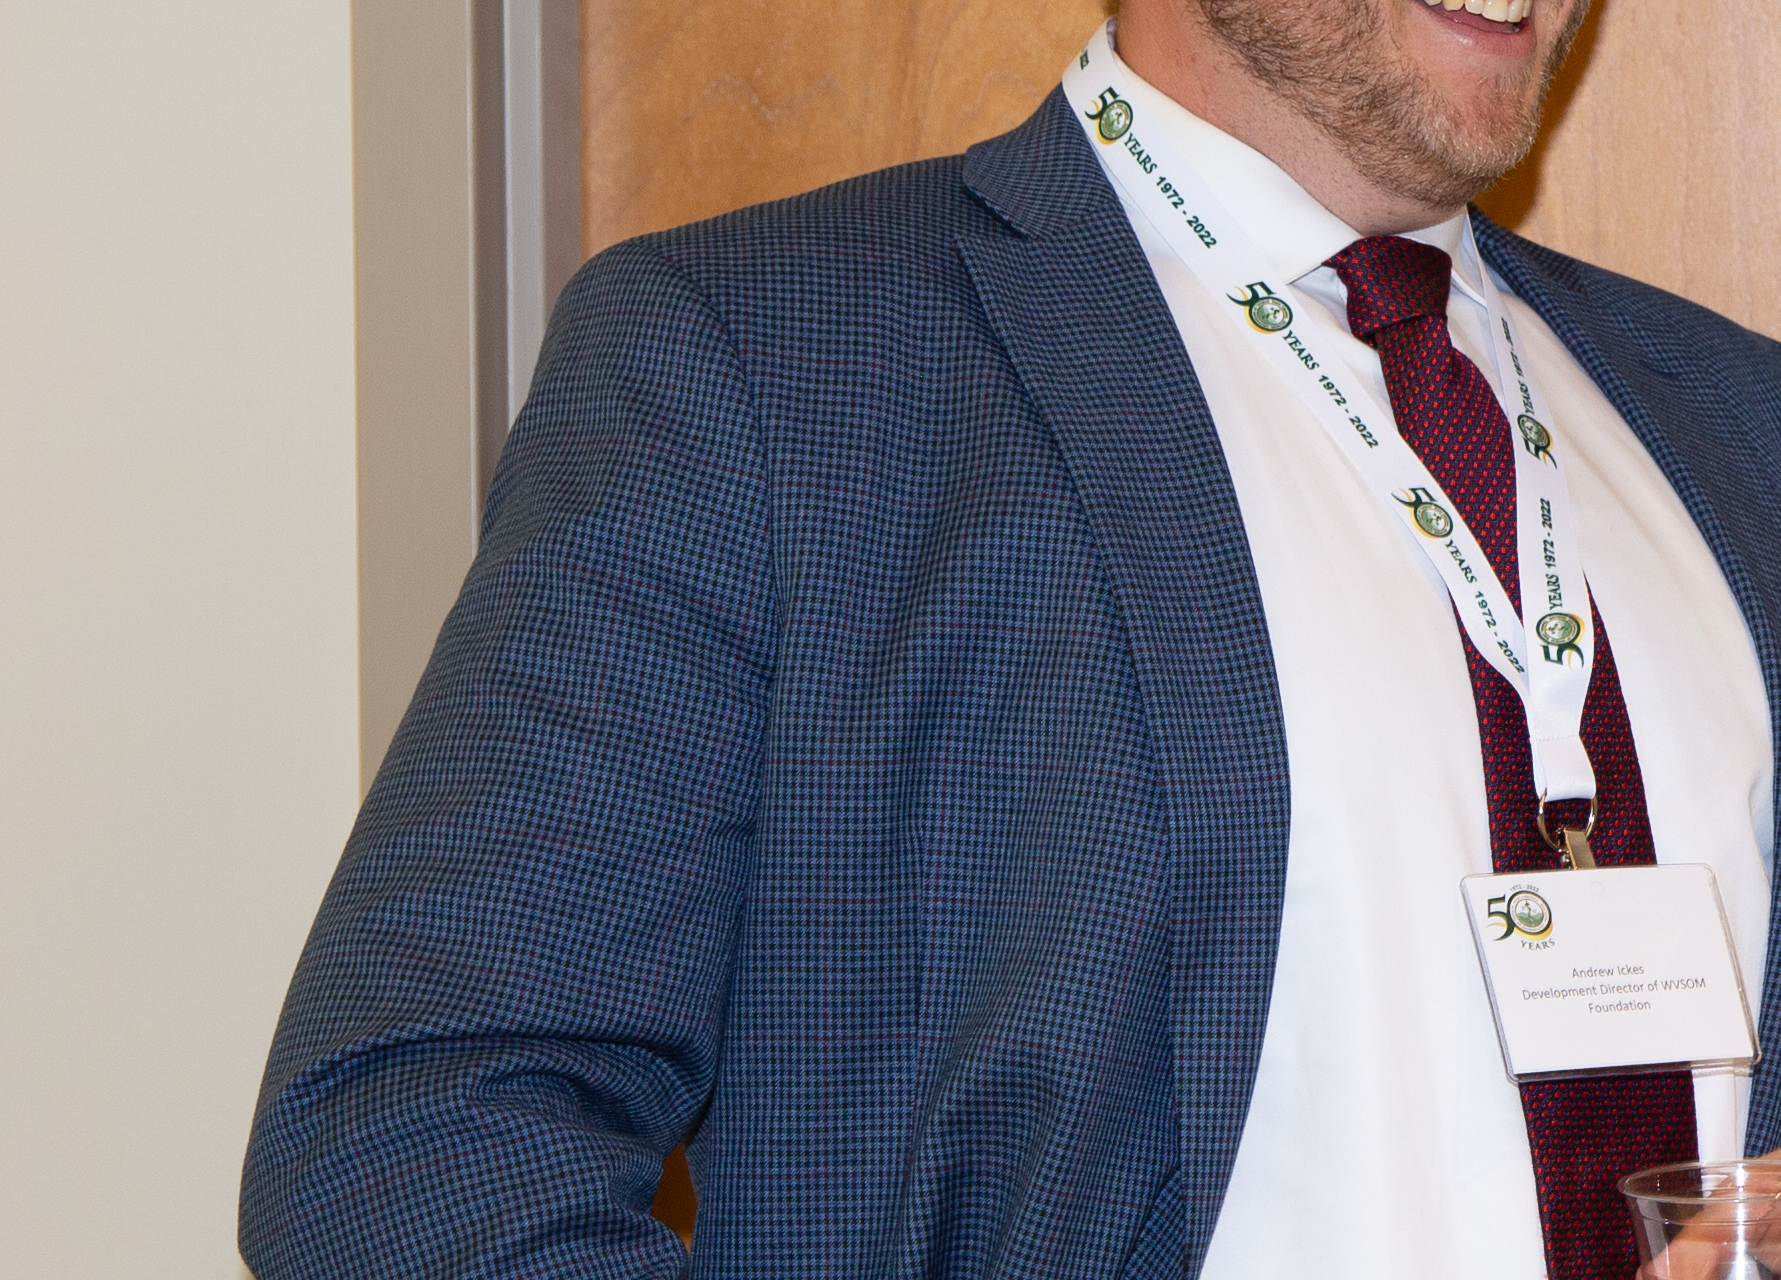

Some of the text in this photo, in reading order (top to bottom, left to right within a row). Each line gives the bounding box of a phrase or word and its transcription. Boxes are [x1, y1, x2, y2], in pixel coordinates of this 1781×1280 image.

[1124, 132, 1157, 174] YEARS
[1156, 176, 1185, 210] 1972
[1186, 215, 1217, 249] 2022
[1282, 330, 1320, 371] YEARS
[1318, 374, 1347, 407] 1972
[1349, 415, 1379, 449] 2022
[1540, 498, 1553, 530] 2022
[1543, 539, 1557, 568] 1972
[1445, 539, 1478, 584] YEARS
[1474, 590, 1497, 628] 1972
[1497, 640, 1525, 674] 2022
[1546, 573, 1563, 611] YEARS
[1521, 938, 1555, 951] YEARS
[1571, 964, 1645, 979] Andrew Ickes
[1522, 977, 1707, 1001] Development Director of WVSOM
[1588, 1000, 1651, 1014] Foundation
